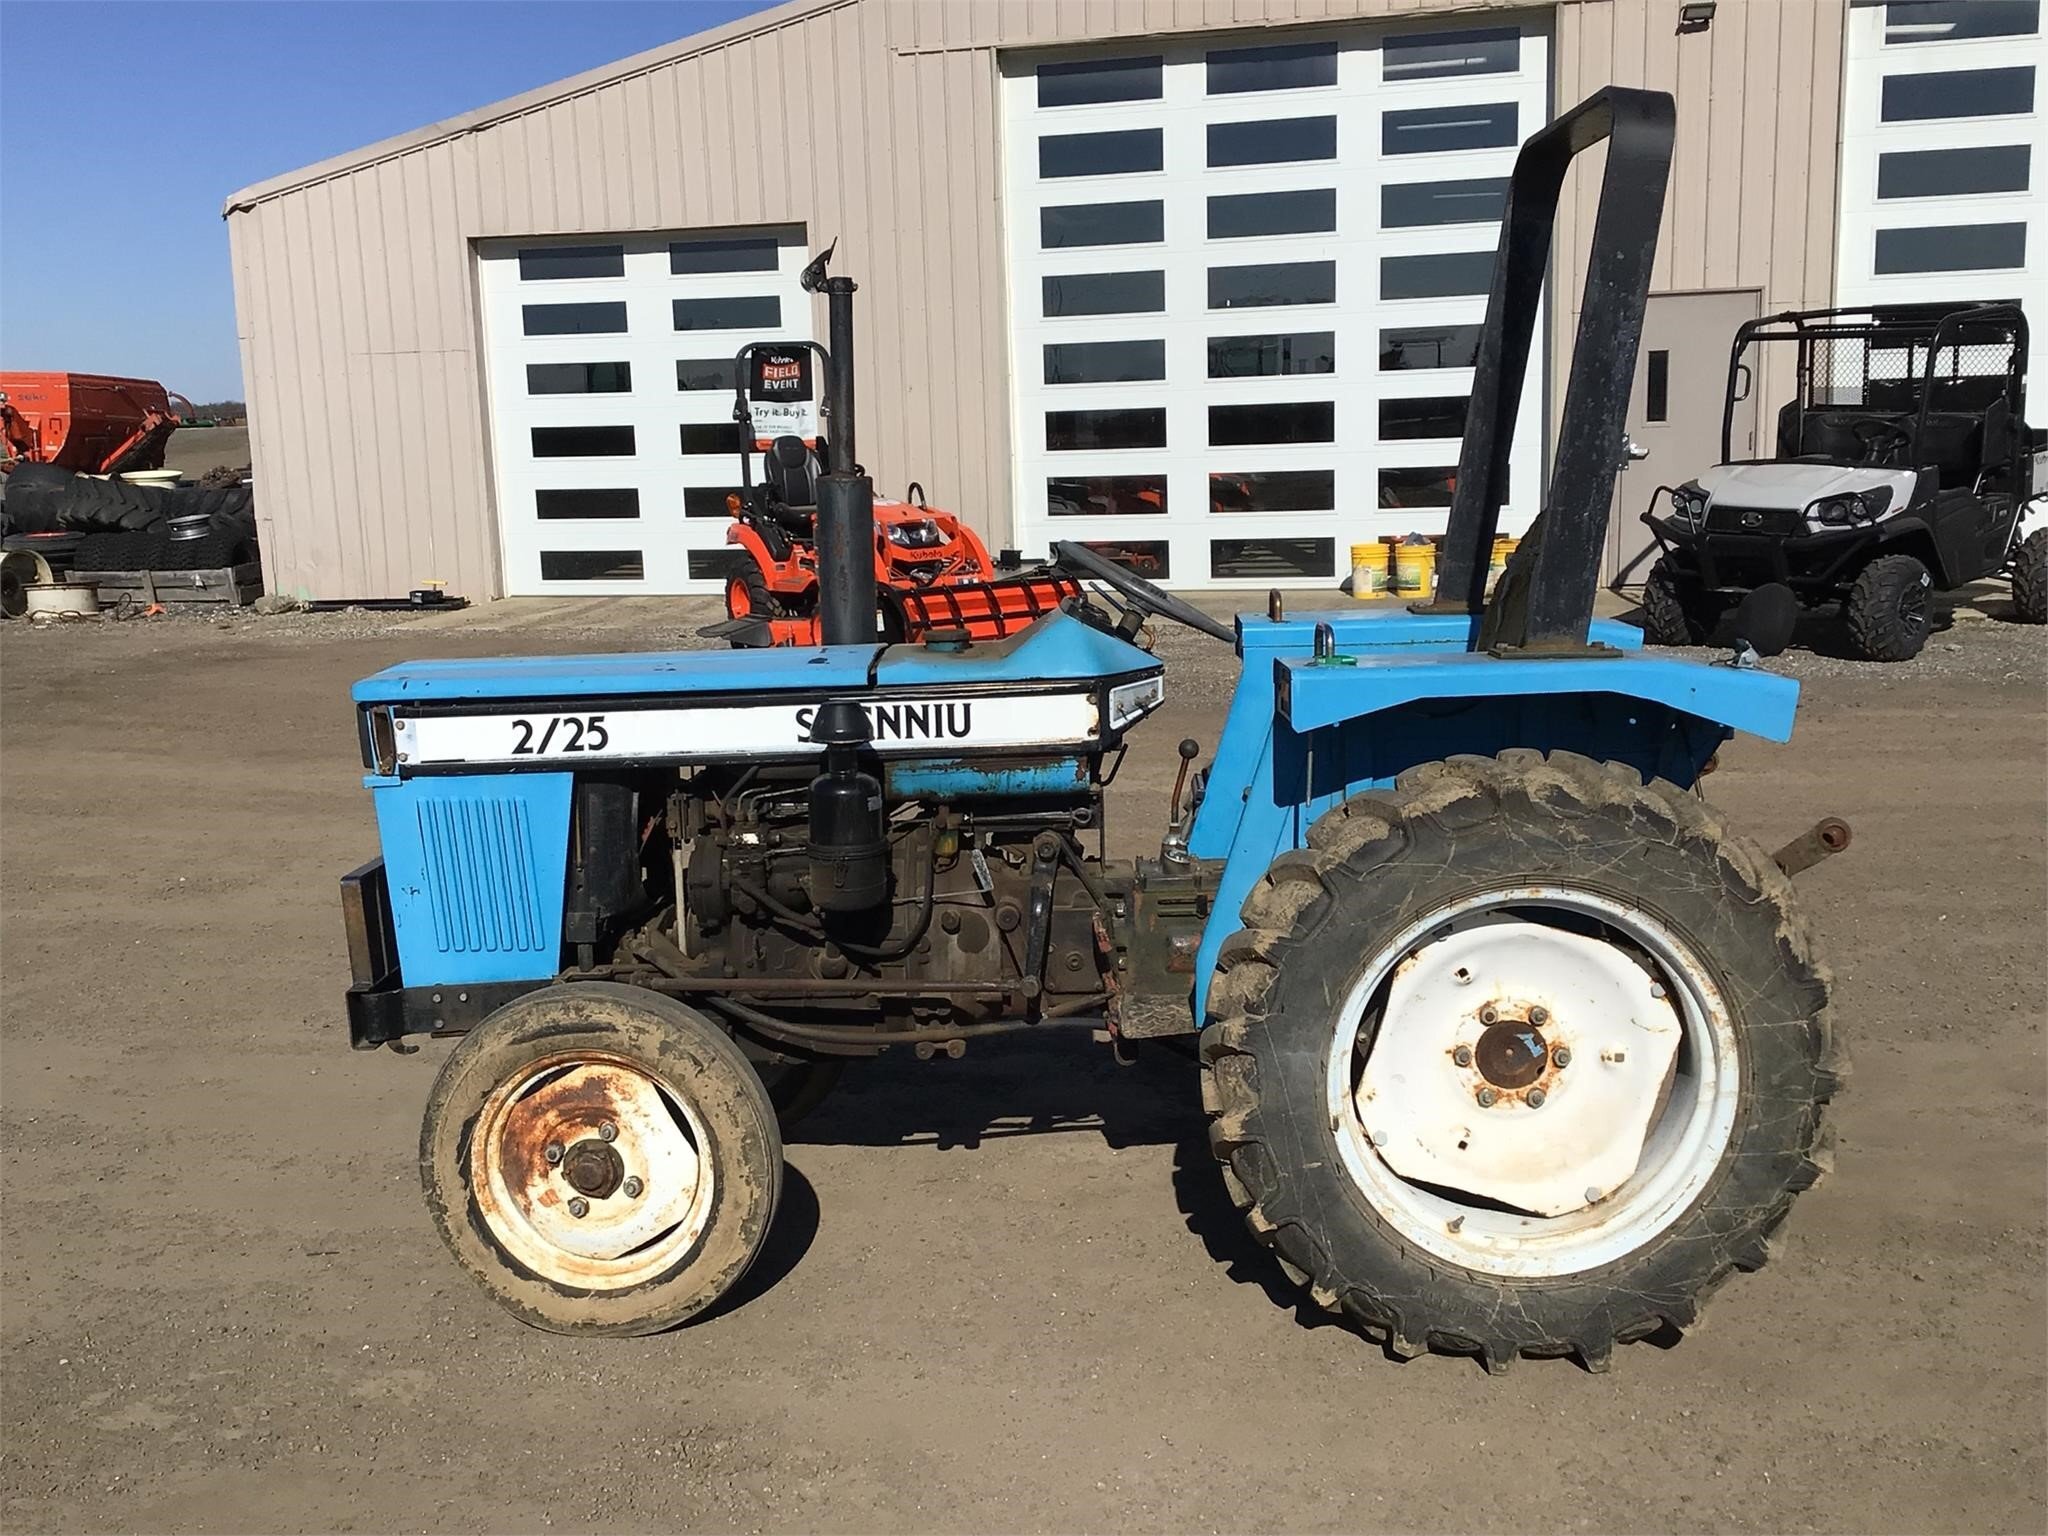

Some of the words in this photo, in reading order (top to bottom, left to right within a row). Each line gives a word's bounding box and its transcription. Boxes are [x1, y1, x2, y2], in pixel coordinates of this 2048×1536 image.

[764, 365, 798, 378] FIELD
[764, 379, 799, 389] EVENT
[754, 407, 769, 418] Try
[783, 407, 800, 419] Buy
[511, 715, 609, 755] 2/25
[795, 702, 972, 743] SNNIU
